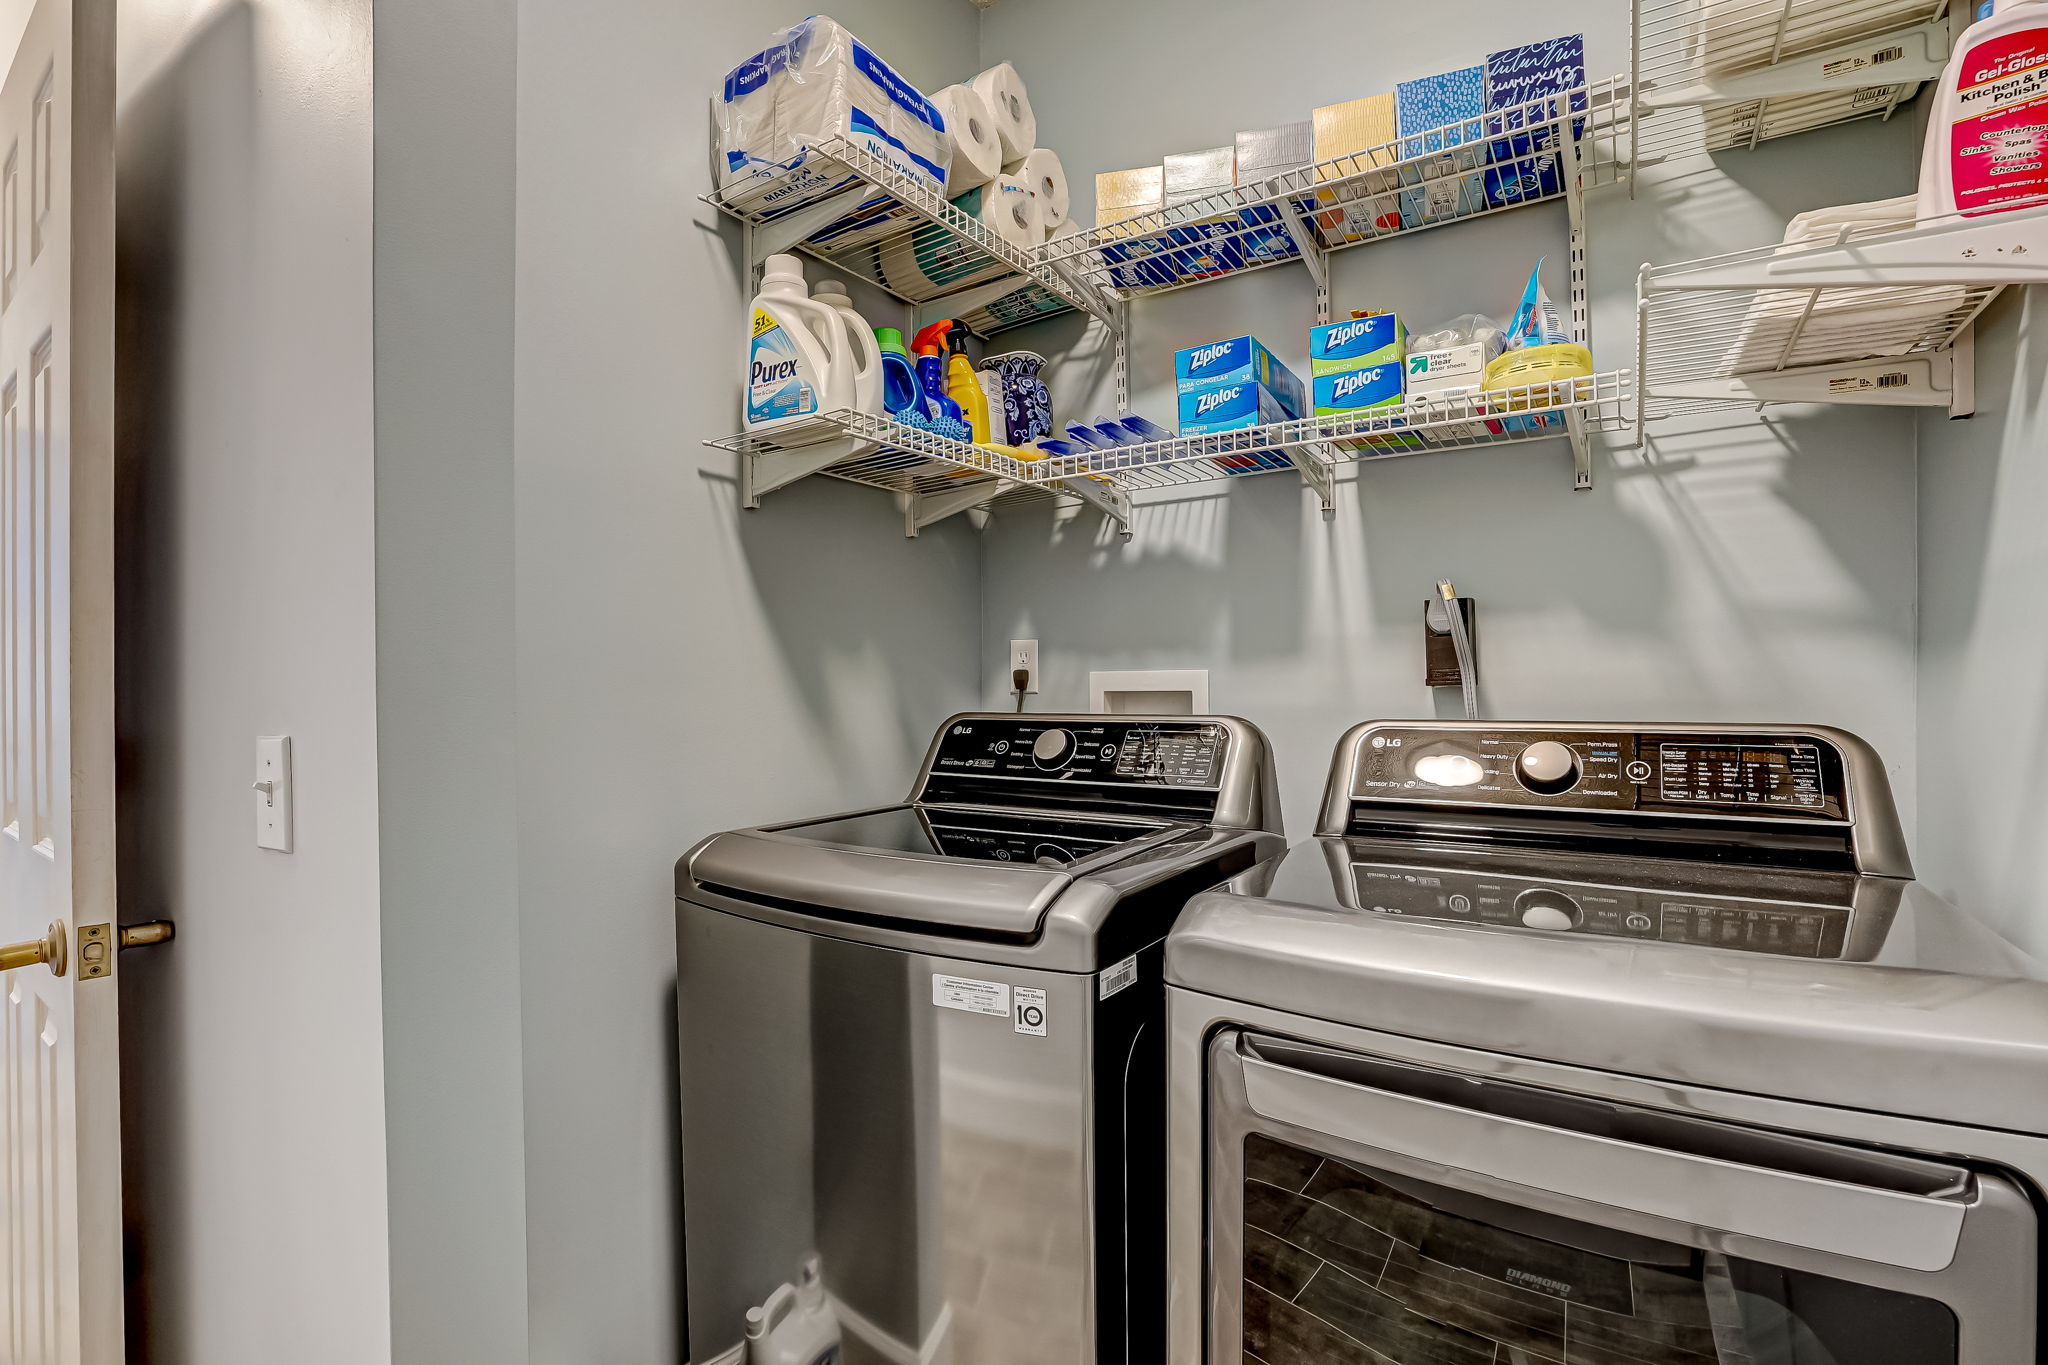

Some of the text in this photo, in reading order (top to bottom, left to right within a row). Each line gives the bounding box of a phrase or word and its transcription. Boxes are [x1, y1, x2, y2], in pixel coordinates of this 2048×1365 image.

[2008, 47, 2035, 60] Original
[739, 63, 771, 85] NAPKINS
[1974, 53, 2048, 83] Gel-Glos
[1960, 79, 2020, 104] Kitchen
[2022, 74, 2035, 84] &
[1994, 83, 2041, 102] Polish
[1980, 111, 2006, 123] Cream
[1961, 145, 1992, 156] Sinks
[2005, 139, 2032, 148] Spas
[1993, 151, 2039, 162] Vanities
[1991, 163, 2041, 175] Showers
[763, 173, 828, 203] MARATHON
[1327, 319, 1374, 349] Ziploc
[1190, 341, 1232, 370] Ziploc
[1430, 357, 1452, 367] clear
[750, 358, 798, 386] Purex
[1314, 363, 1352, 375] SANDWICH
[1446, 361, 1467, 370] sheets
[1179, 374, 1229, 390] PARA CONGELAR
[1334, 368, 1382, 398] Ziploc
[1197, 386, 1240, 413] Ziploc
[1181, 425, 1208, 433] FREEZER
[1386, 738, 1401, 747] LG
[1389, 780, 1401, 788] Dry
[1017, 1005, 1043, 1027] 10
[1506, 1268, 1572, 1293] DIAMOND
